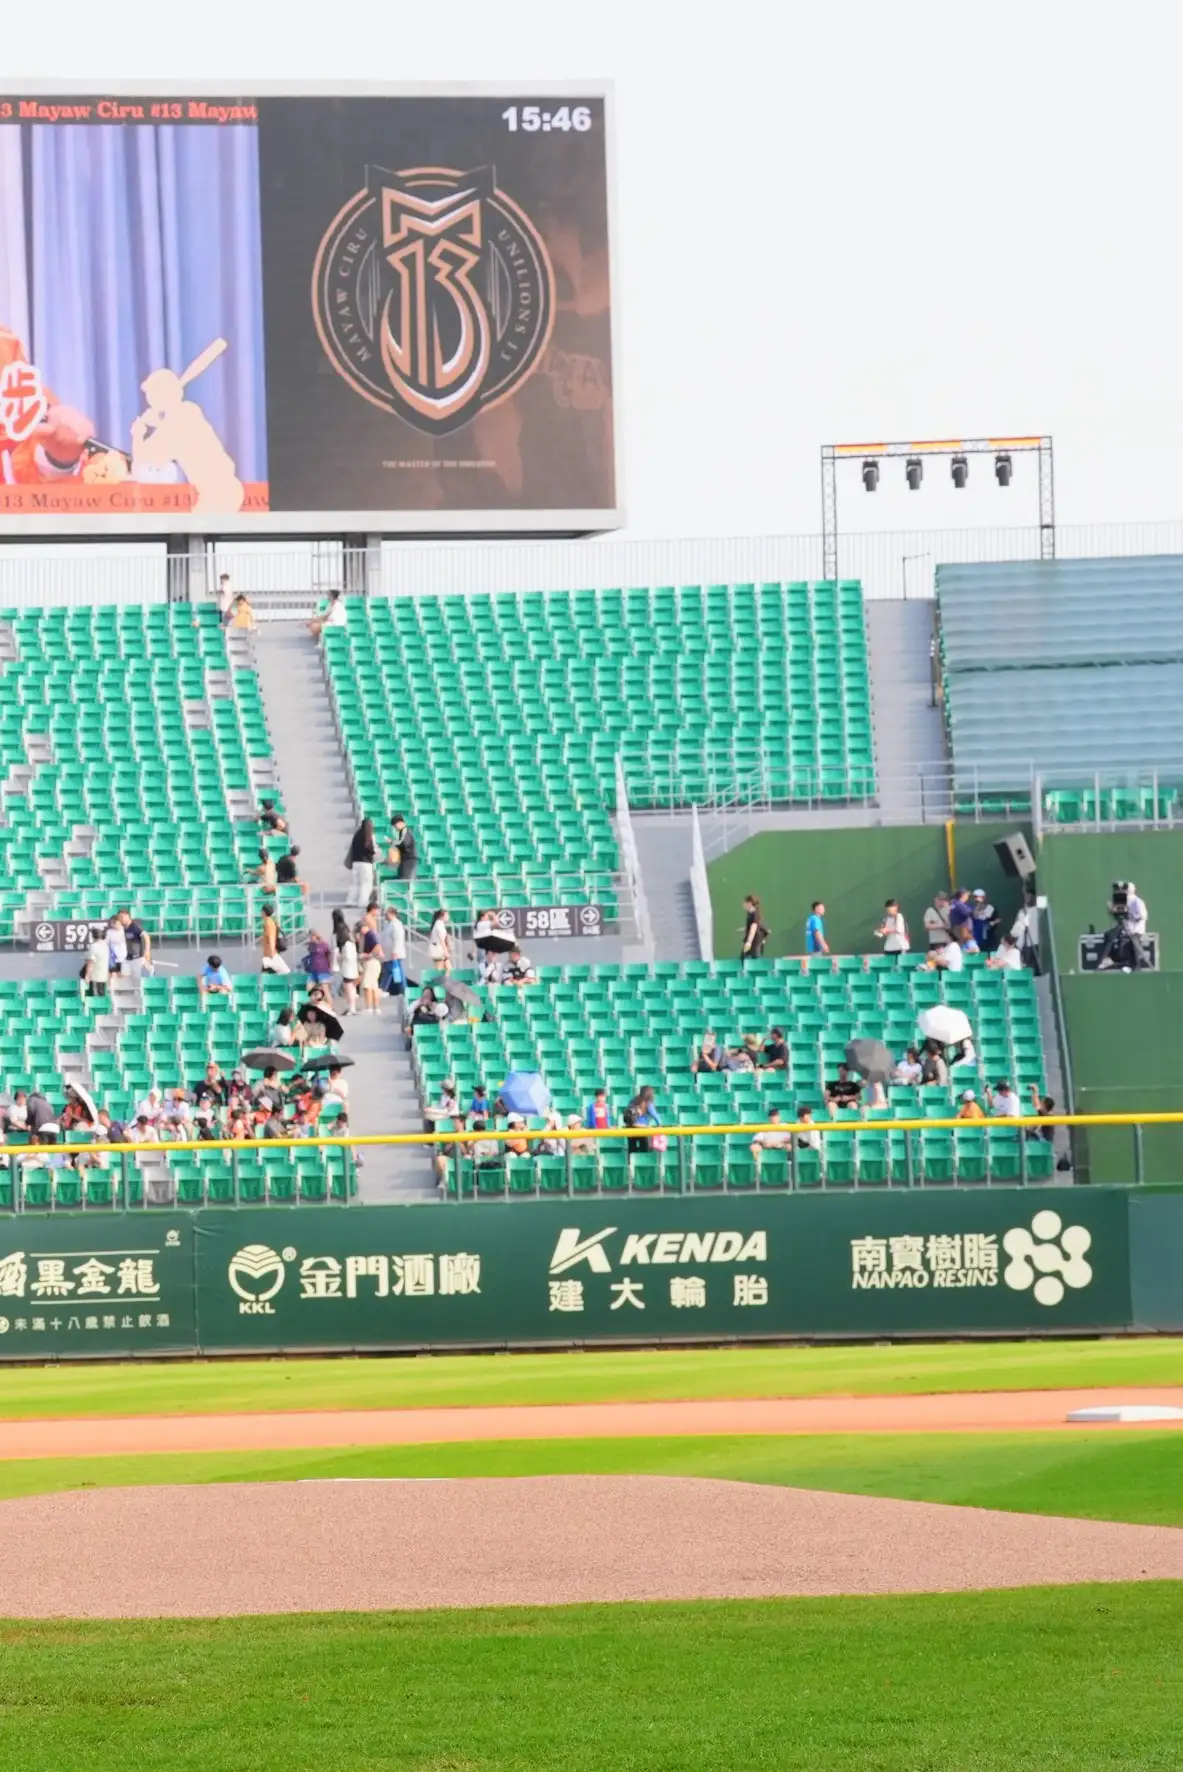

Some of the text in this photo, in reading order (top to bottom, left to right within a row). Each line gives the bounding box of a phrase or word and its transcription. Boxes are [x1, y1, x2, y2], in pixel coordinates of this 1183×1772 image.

[19, 102, 91, 121] Mayaw
[97, 102, 144, 118] Ciru
[151, 103, 182, 118] #13
[188, 103, 258, 121] Mayaw
[502, 107, 592, 131] 15:46
[498, 229, 531, 334] UNILIONS
[336, 228, 372, 362] MAYAW CIRU
[31, 494, 101, 511] Mayaw
[110, 493, 154, 508] Ciru
[526, 909, 571, 929] 58區
[620, 1231, 767, 1265] KENDA
[299, 1252, 481, 1299] 金門酒廠
[852, 1268, 999, 1289] NANPAO RESINS
[548, 1274, 768, 1311] 建大輪胎
[239, 1302, 275, 1314] KKL
